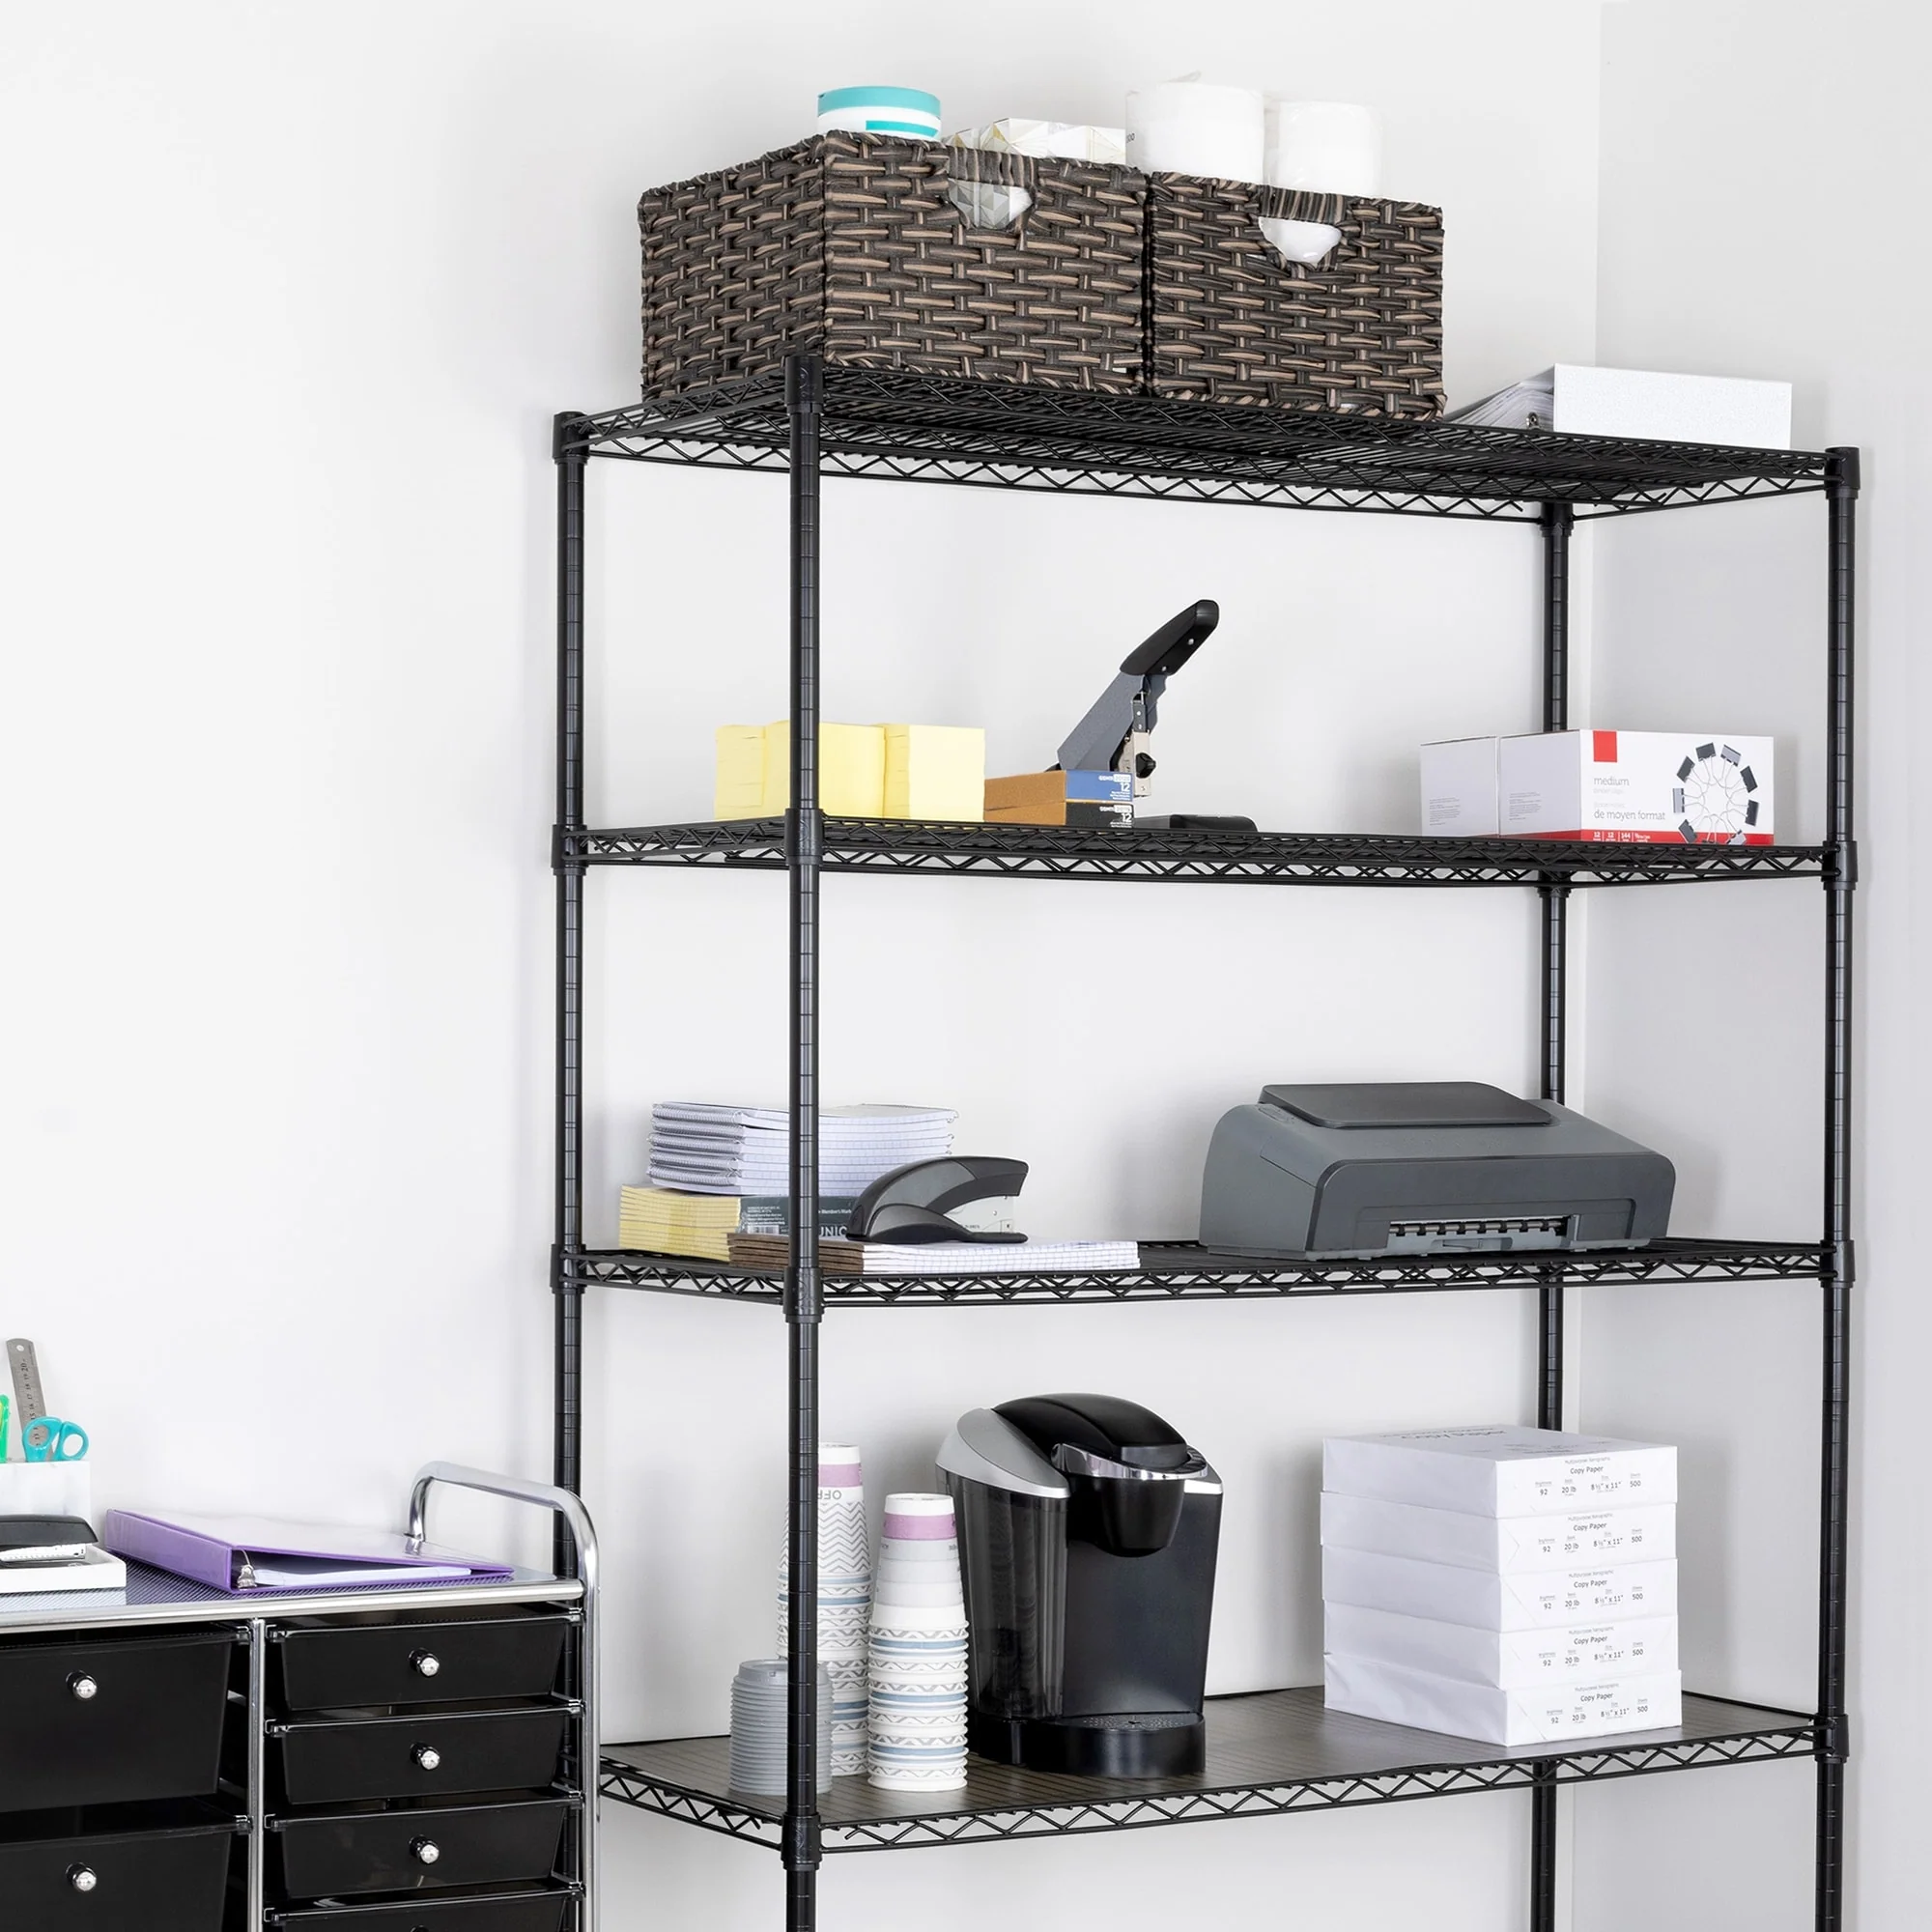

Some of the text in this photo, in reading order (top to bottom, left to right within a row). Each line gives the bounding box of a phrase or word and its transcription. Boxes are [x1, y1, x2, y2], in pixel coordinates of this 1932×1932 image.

[1594, 776, 1630, 786] medium
[1120, 782, 1130, 792] 12
[1122, 813, 1132, 823] 12
[1594, 810, 1666, 822] de moyen format
